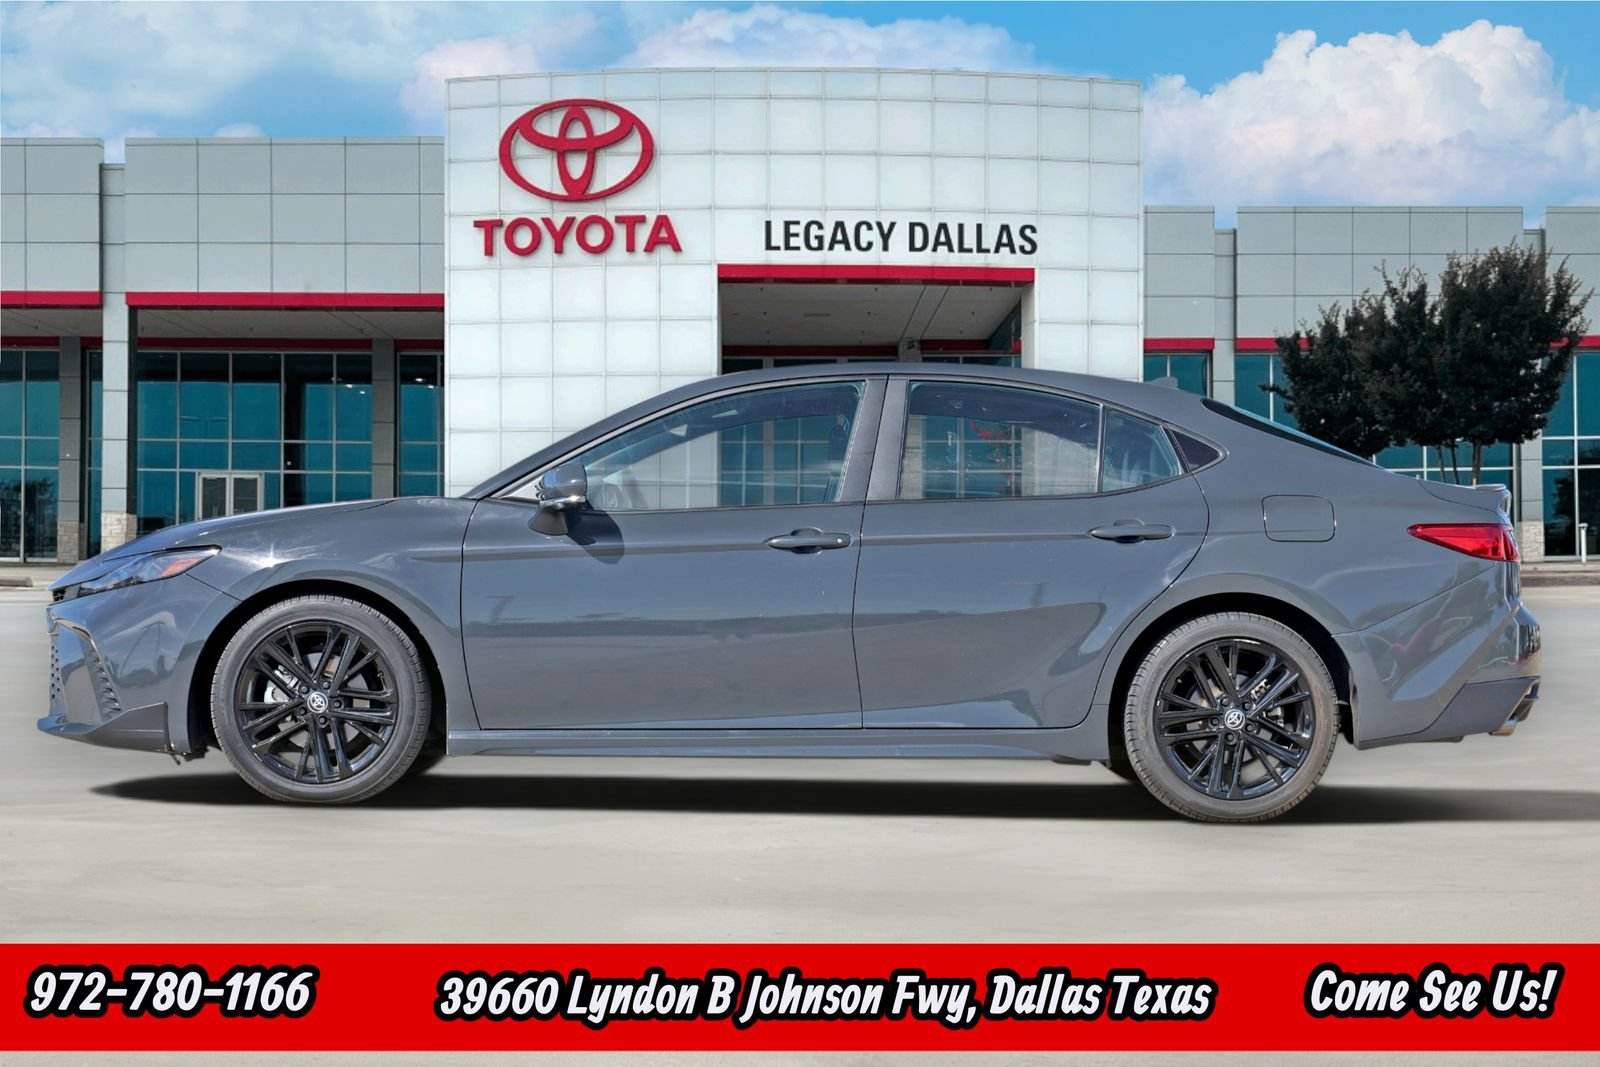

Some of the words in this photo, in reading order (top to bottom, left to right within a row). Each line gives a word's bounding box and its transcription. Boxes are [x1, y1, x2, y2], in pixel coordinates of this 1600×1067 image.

[474, 214, 682, 257] TOYOTA
[765, 220, 897, 252] LEGACY
[908, 221, 1038, 255] DALLAS
